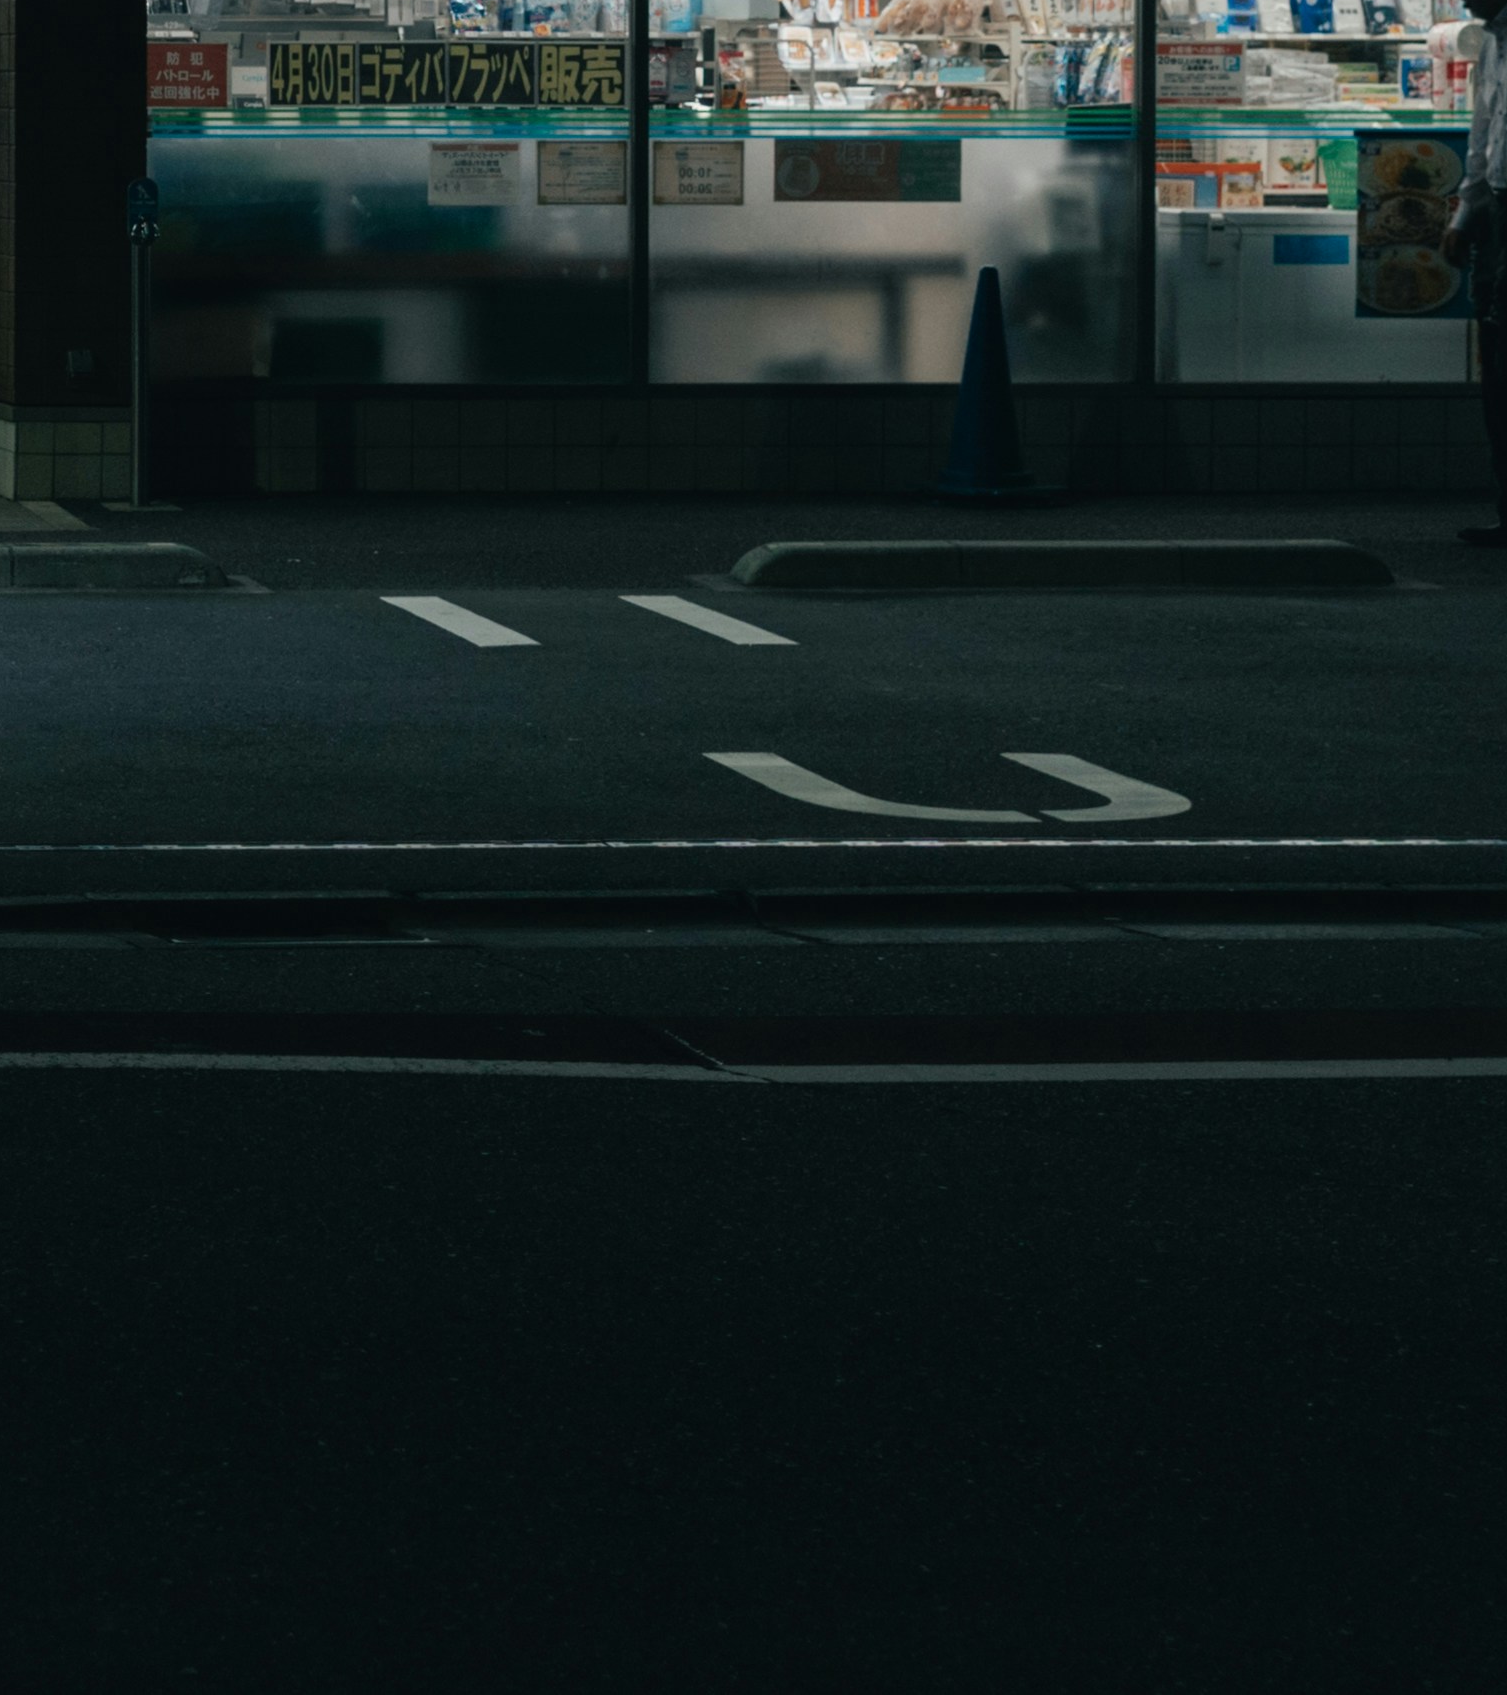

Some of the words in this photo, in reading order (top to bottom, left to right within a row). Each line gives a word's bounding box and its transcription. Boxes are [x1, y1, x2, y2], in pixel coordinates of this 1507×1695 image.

[166, 52, 204, 65] 防犯
[156, 69, 214, 82] パトロール
[272, 44, 353, 104] 4月30日
[361, 45, 444, 104] ゴディバ
[449, 44, 531, 104] フラッペ
[540, 44, 622, 104] 販売
[150, 86, 220, 100] 巡回強化中
